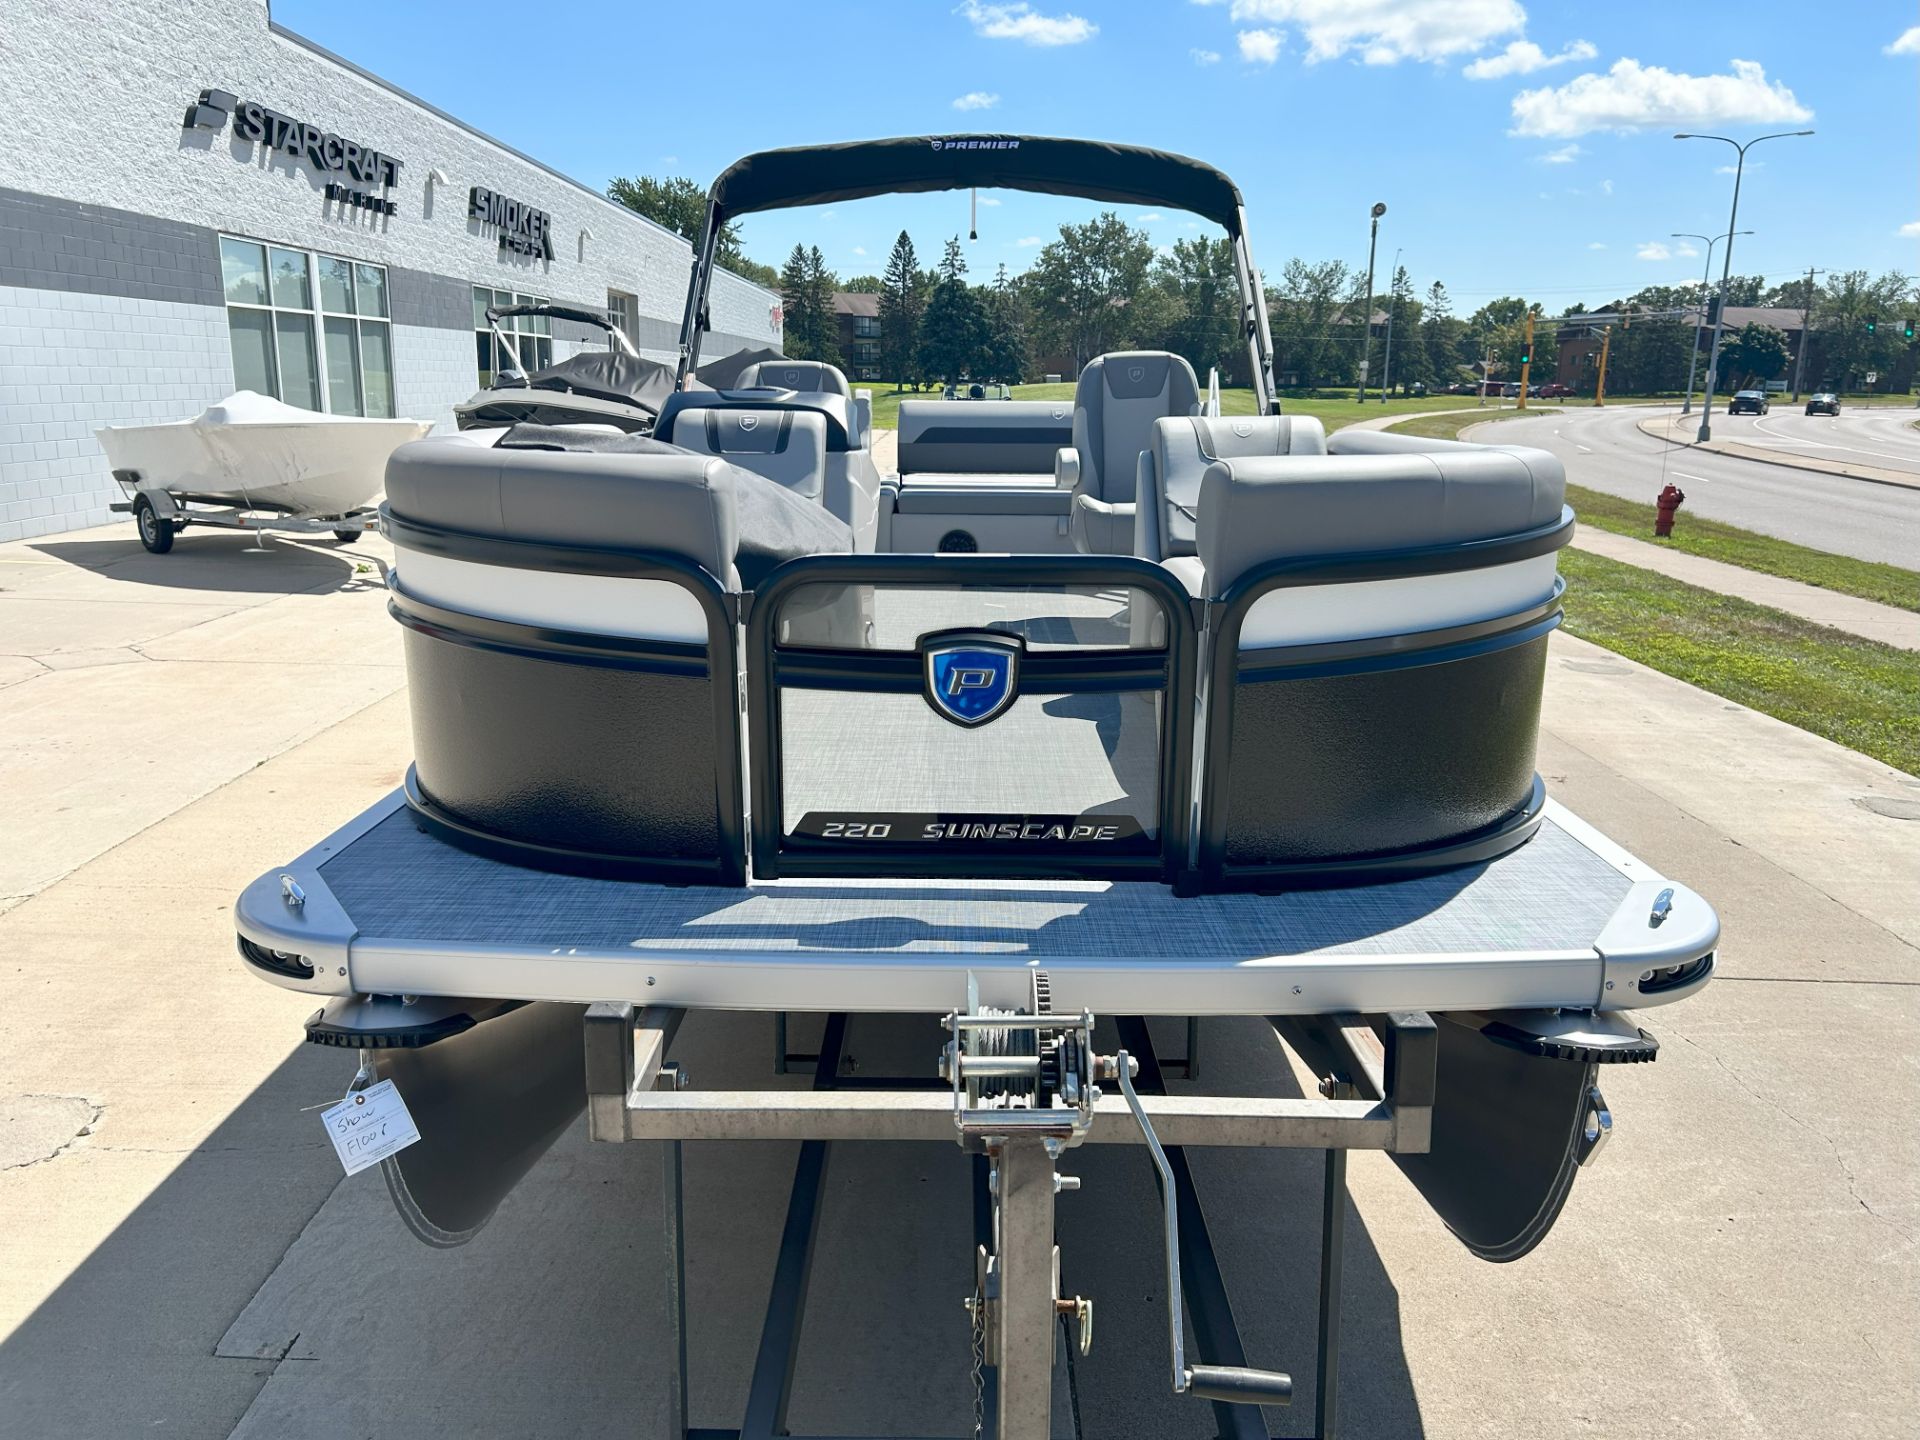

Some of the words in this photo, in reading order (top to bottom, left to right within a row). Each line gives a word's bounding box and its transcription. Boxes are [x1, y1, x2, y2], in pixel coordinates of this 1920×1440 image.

[238, 101, 404, 187] STARCRAFT
[945, 141, 1019, 149] PREMIER
[327, 184, 397, 216] MARINE
[469, 186, 555, 256] SMOKER
[501, 235, 545, 259] CRAFT
[948, 667, 995, 695] P
[822, 823, 891, 838] 220
[921, 823, 1120, 840] SUNSCAPE
[337, 1108, 375, 1133] Show
[347, 1122, 388, 1155] Floor
